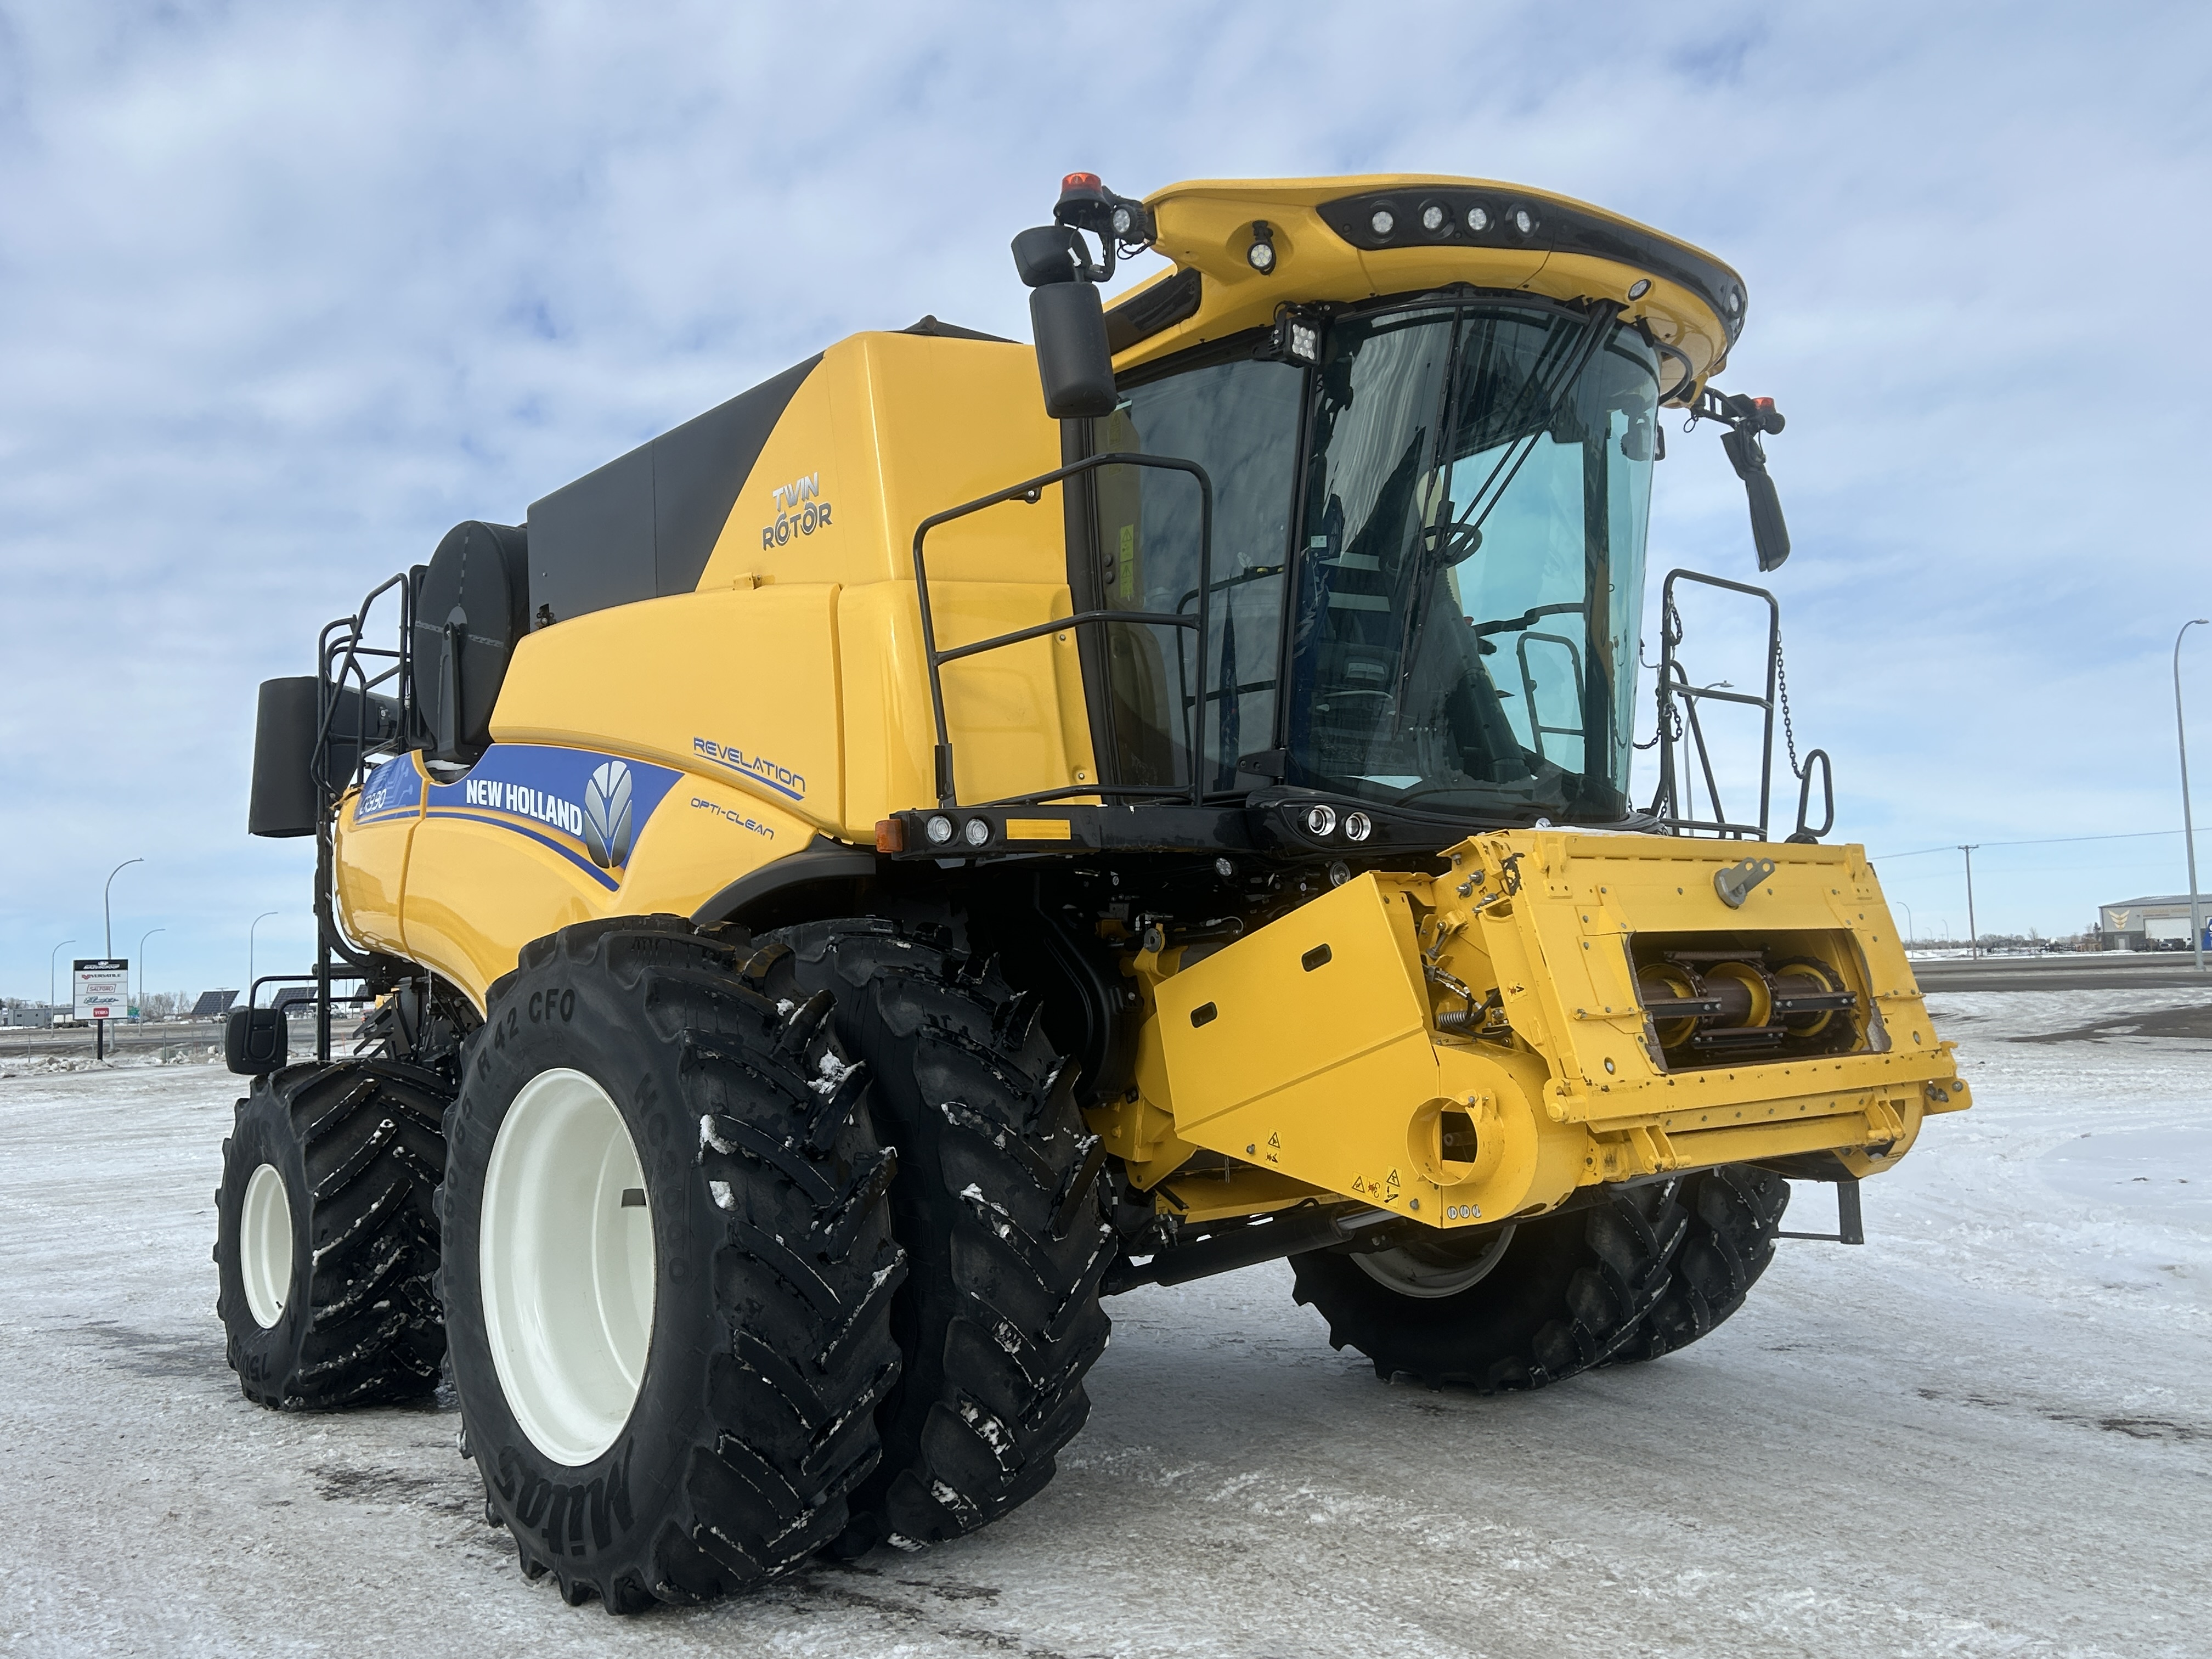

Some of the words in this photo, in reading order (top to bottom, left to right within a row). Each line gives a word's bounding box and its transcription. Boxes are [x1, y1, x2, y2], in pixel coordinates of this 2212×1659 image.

[772, 471, 819, 512] TWIN
[763, 501, 833, 551] ROTOR
[693, 736, 805, 792] REVELATION
[466, 779, 503, 808] NEW
[506, 783, 583, 836] HOLLAND
[691, 798, 775, 840] OPTI-CLEAN
[494, 1007, 519, 1050] 42
[528, 989, 575, 1024] CFO
